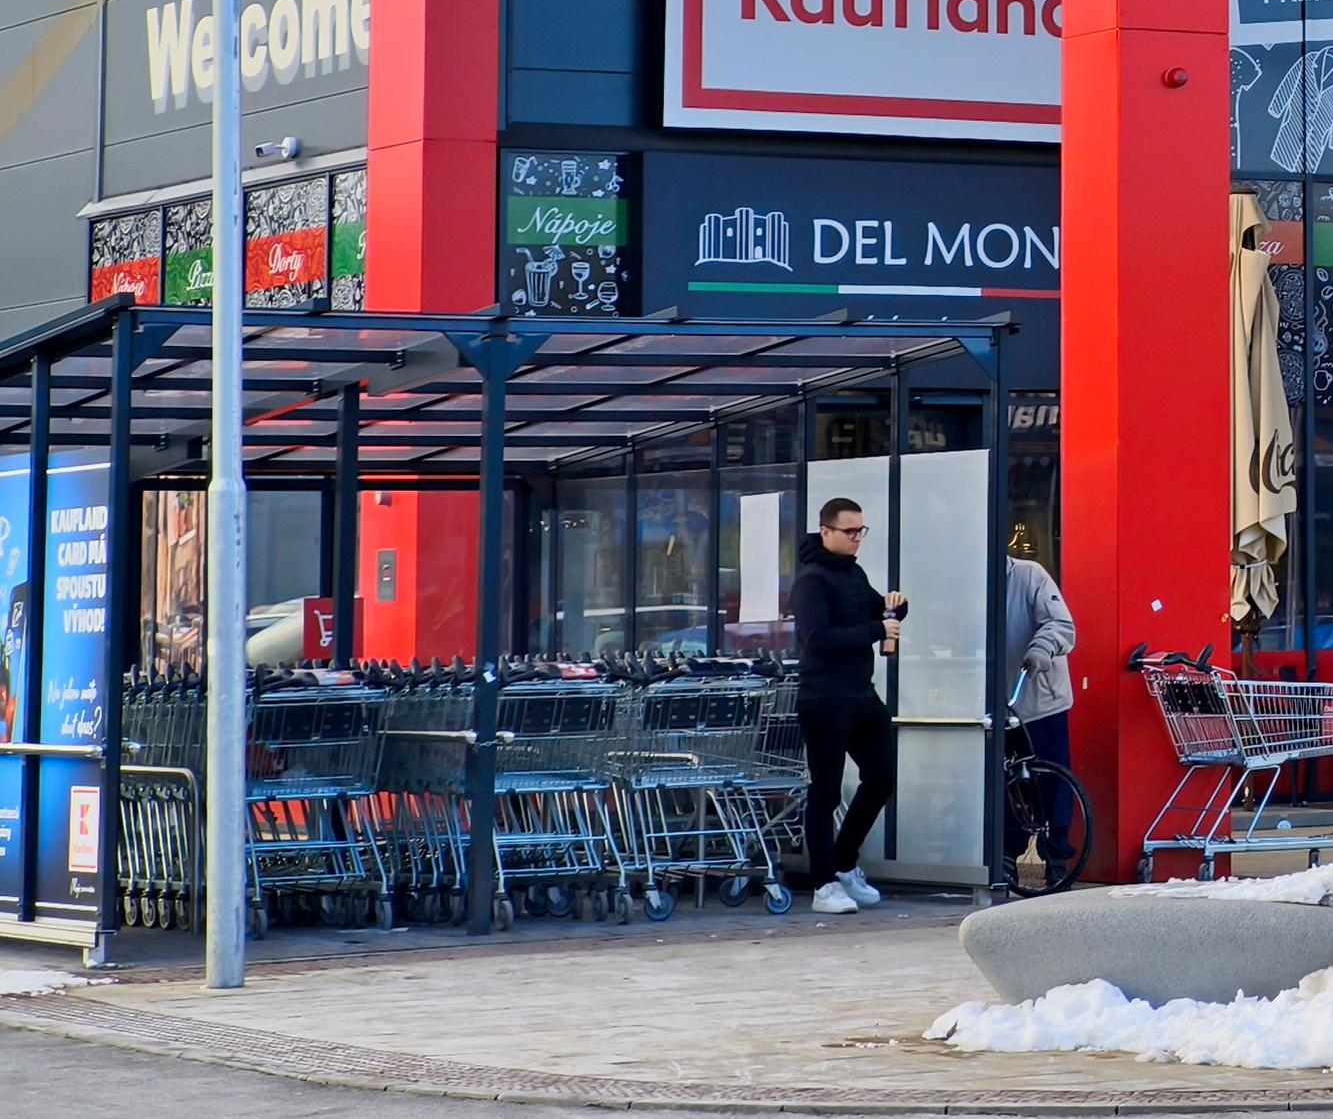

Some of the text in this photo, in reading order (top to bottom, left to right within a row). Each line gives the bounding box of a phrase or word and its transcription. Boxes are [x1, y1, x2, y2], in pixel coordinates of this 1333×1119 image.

[516, 205, 618, 245] Nápoje
[813, 218, 1061, 270] DEL MON
[268, 242, 305, 282] Dorty
[51, 505, 108, 535] KAUFLAND
[57, 539, 87, 567] CARD
[56, 573, 106, 602] SPOUSTU
